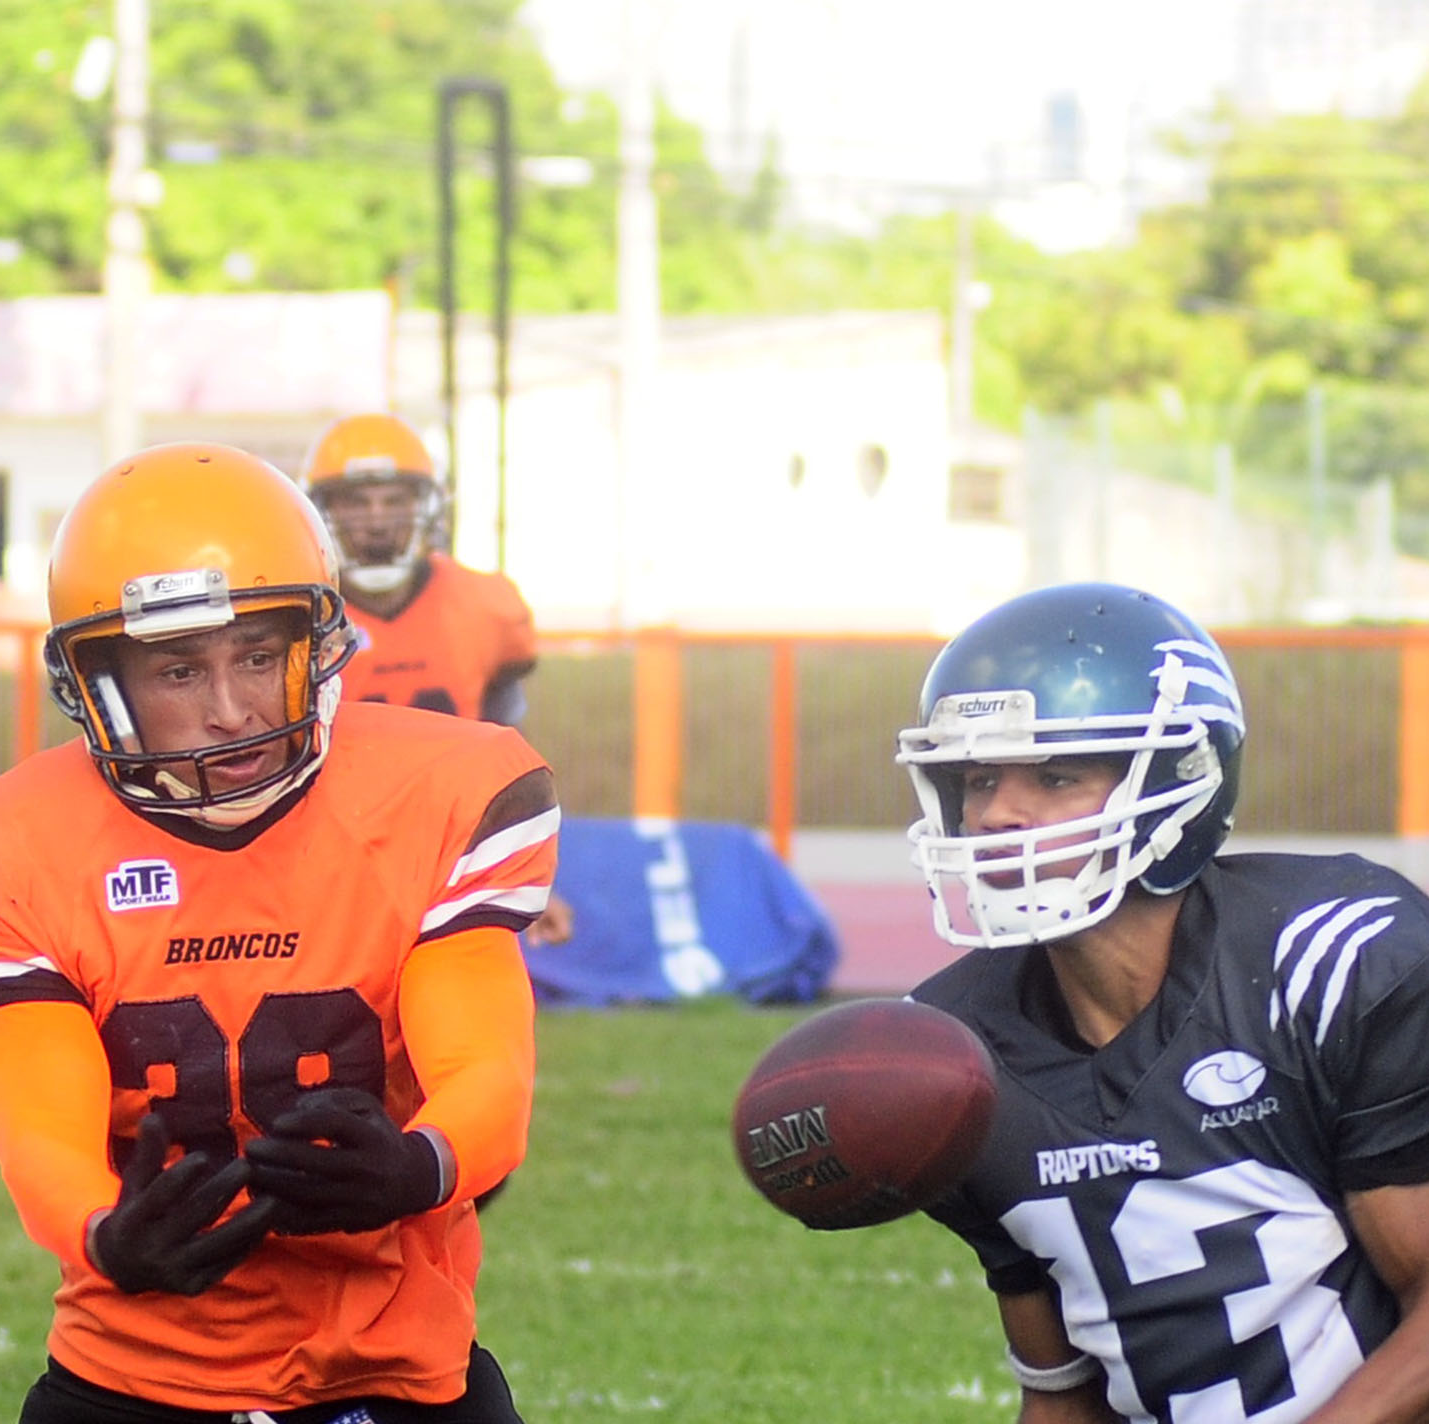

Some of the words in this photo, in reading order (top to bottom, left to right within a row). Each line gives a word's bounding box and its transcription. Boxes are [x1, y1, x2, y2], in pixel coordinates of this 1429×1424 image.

[111, 865, 172, 899] MTF
[164, 932, 300, 965] BRONCOS
[1036, 1139, 1160, 1186] RAPTORS
